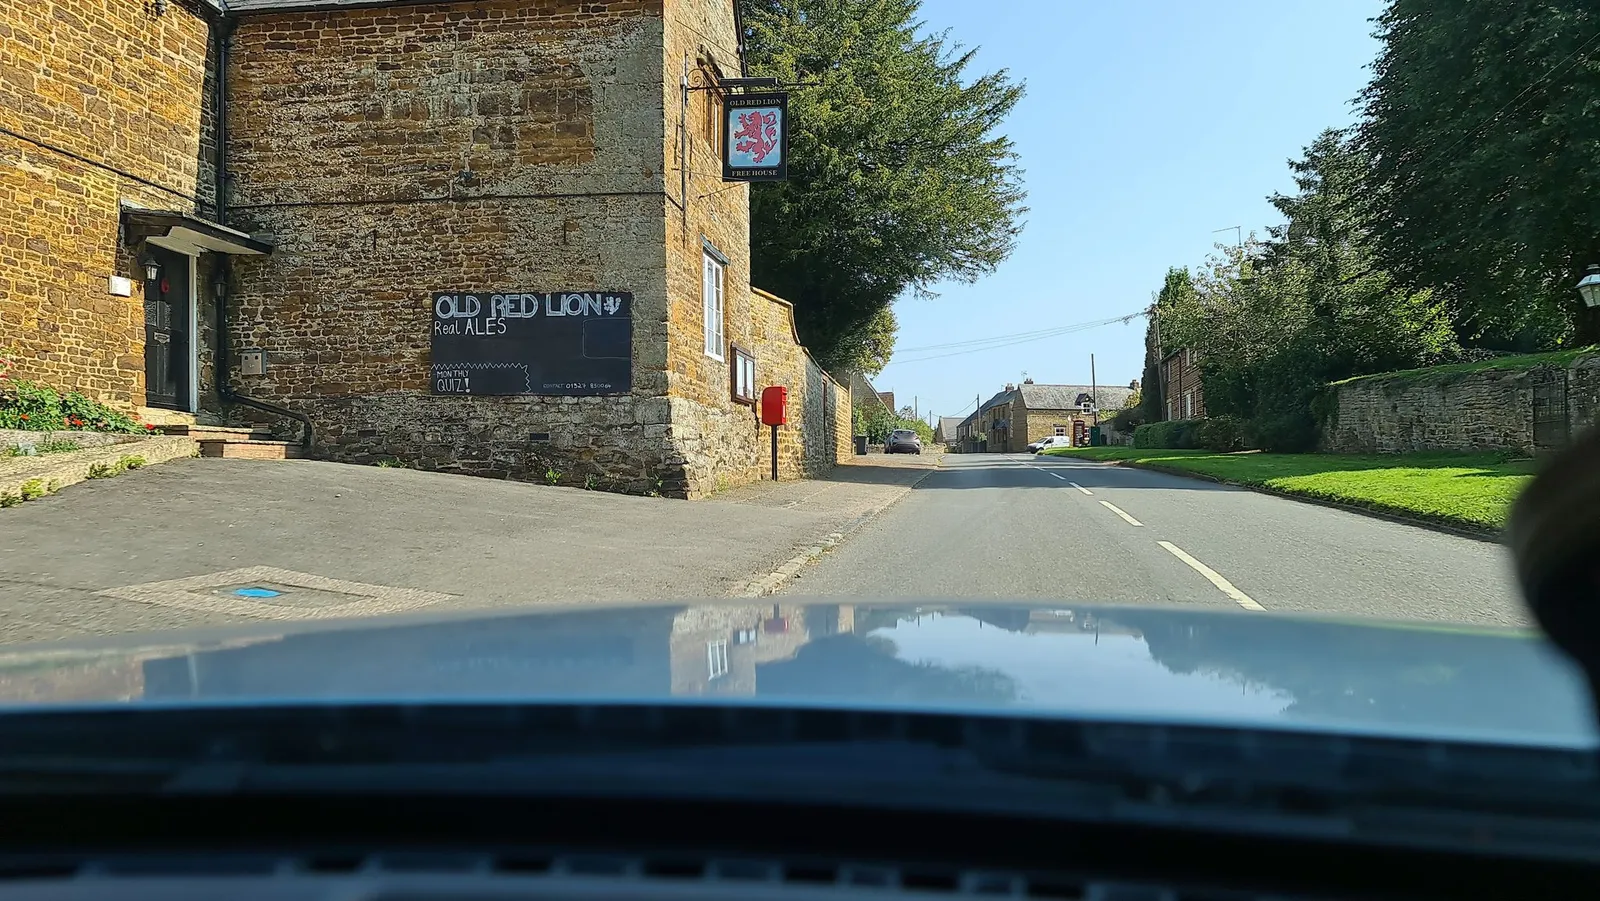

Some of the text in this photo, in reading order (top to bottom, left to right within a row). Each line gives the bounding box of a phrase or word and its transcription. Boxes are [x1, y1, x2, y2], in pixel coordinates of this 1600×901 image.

[435, 293, 602, 319] OLD RED LION
[434, 317, 507, 336] Real ALES
[436, 369, 470, 379] MONTHLY
[436, 378, 471, 393] QUIZ!
